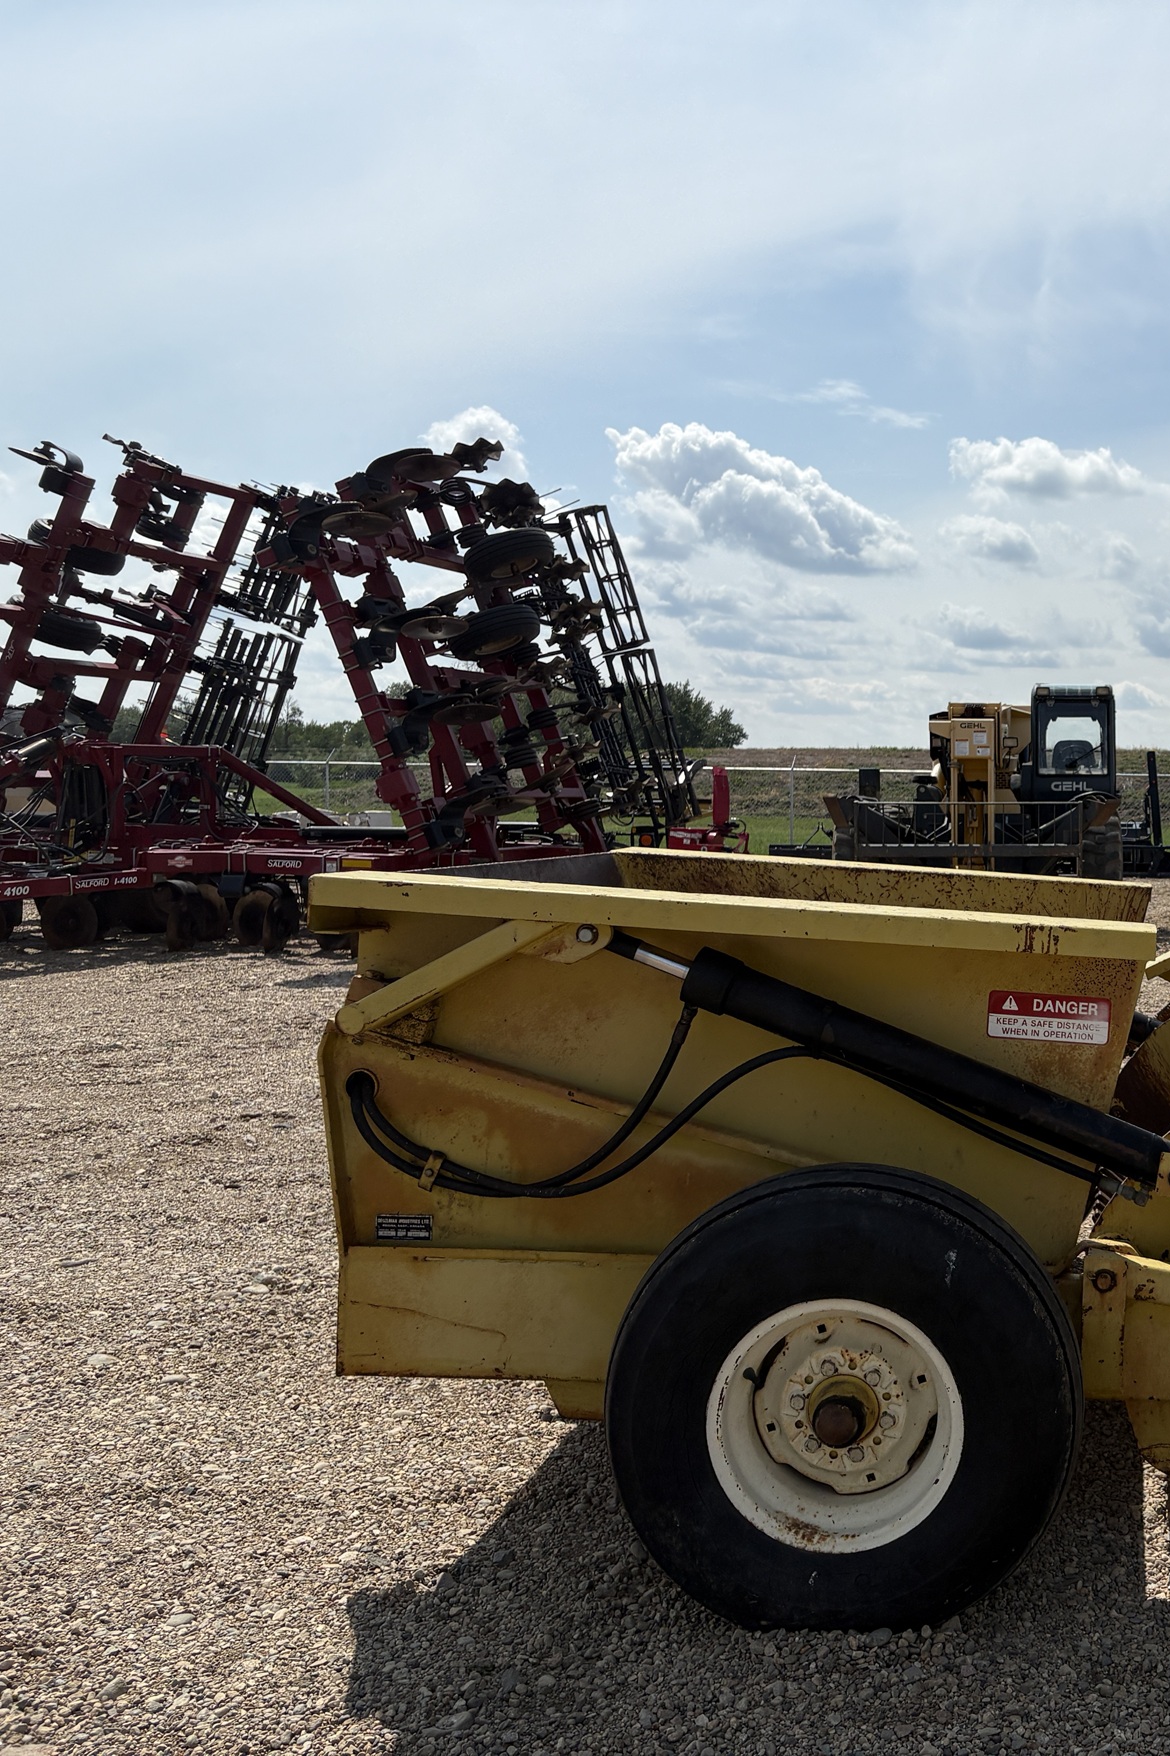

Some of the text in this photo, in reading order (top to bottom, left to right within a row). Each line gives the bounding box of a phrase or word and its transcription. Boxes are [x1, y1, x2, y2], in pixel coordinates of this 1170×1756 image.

[1051, 781, 1093, 792] GEHL
[267, 858, 303, 869] SALFORD
[74, 877, 110, 889] SALFORD
[1032, 998, 1098, 1016] DANGER
[996, 1017, 1101, 1032] KEEP A SAFE DISTANCE
[1002, 1027, 1094, 1041] WHEN IN OPERATION
